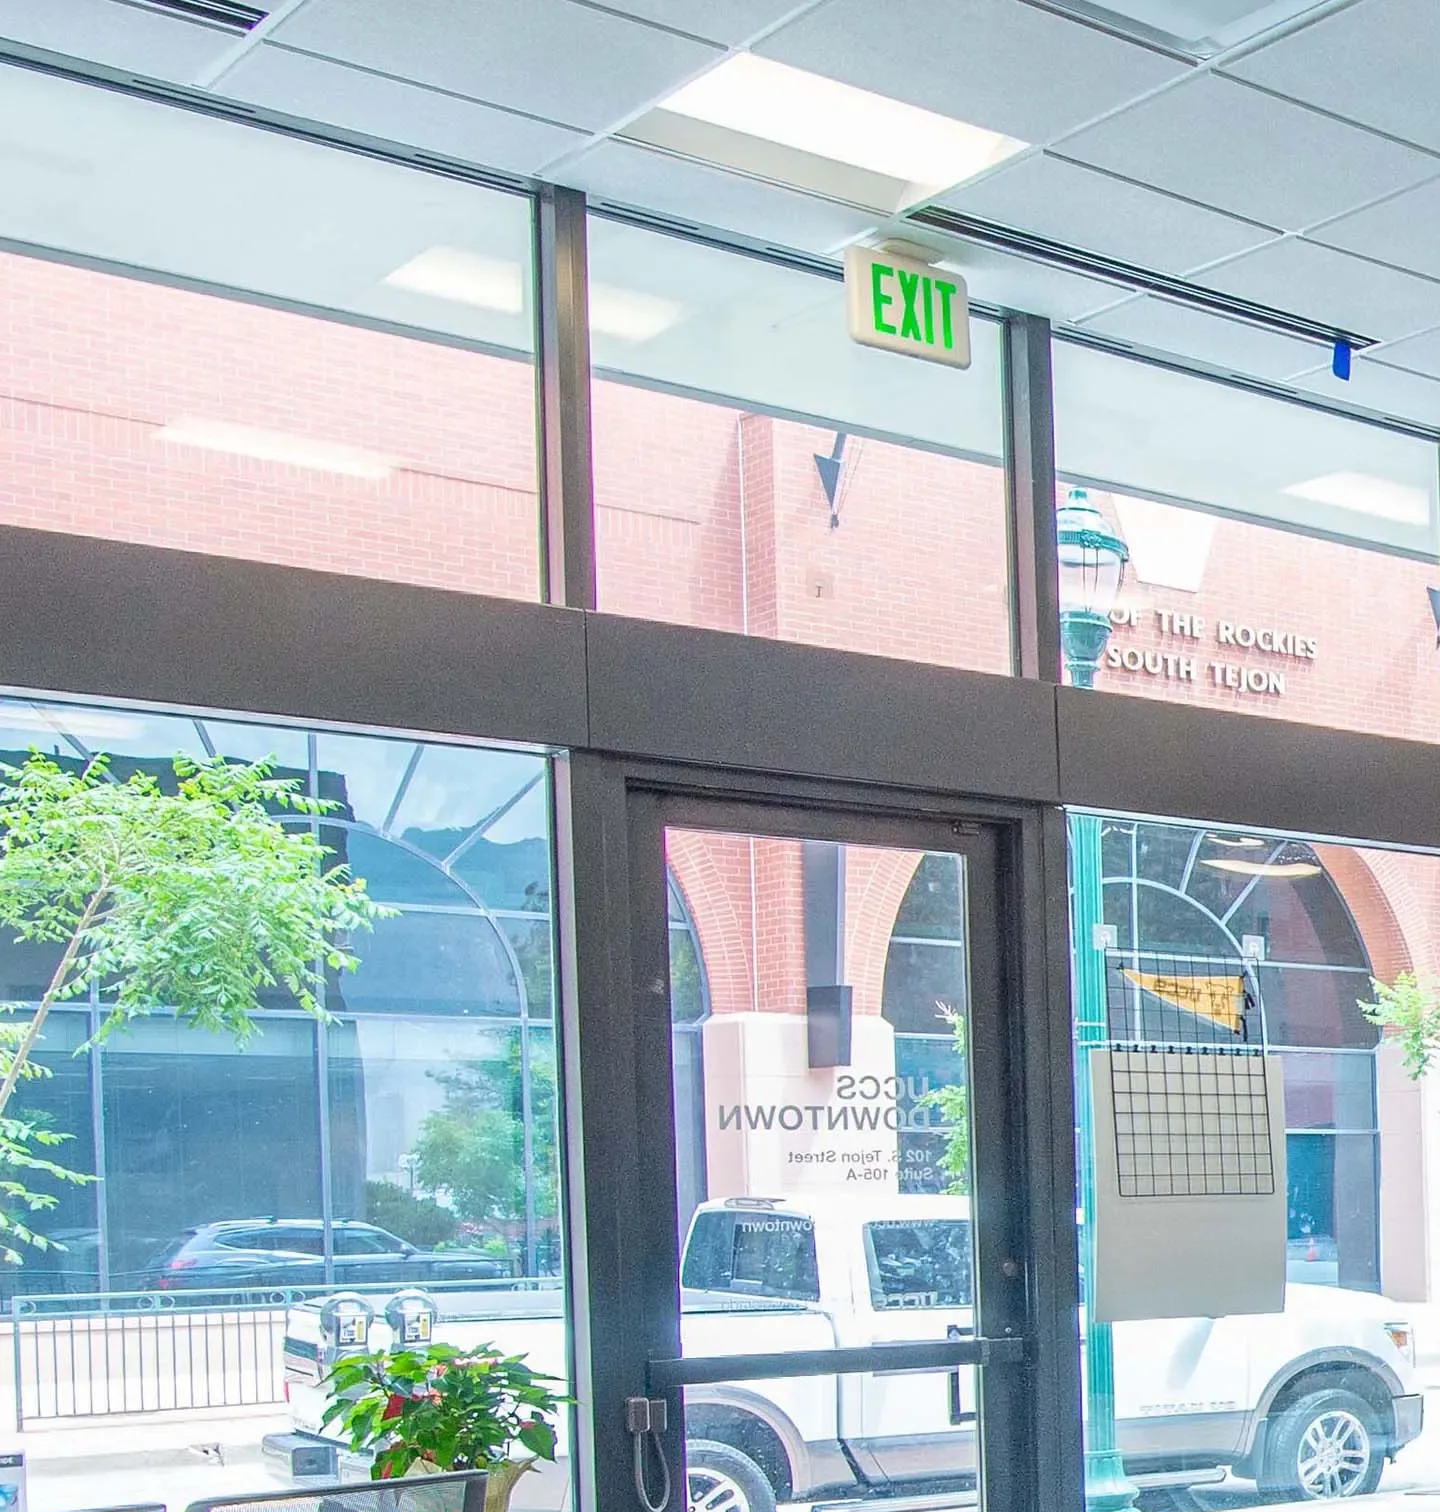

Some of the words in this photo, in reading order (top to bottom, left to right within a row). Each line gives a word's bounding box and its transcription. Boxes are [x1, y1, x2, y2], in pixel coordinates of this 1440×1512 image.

[872, 262, 957, 350] EXIT
[1109, 606, 1141, 626] OF
[1155, 609, 1205, 638] THE
[1217, 620, 1318, 660] ROCKIES
[1107, 646, 1198, 681] SOUTH
[1208, 660, 1286, 695] TEJON
